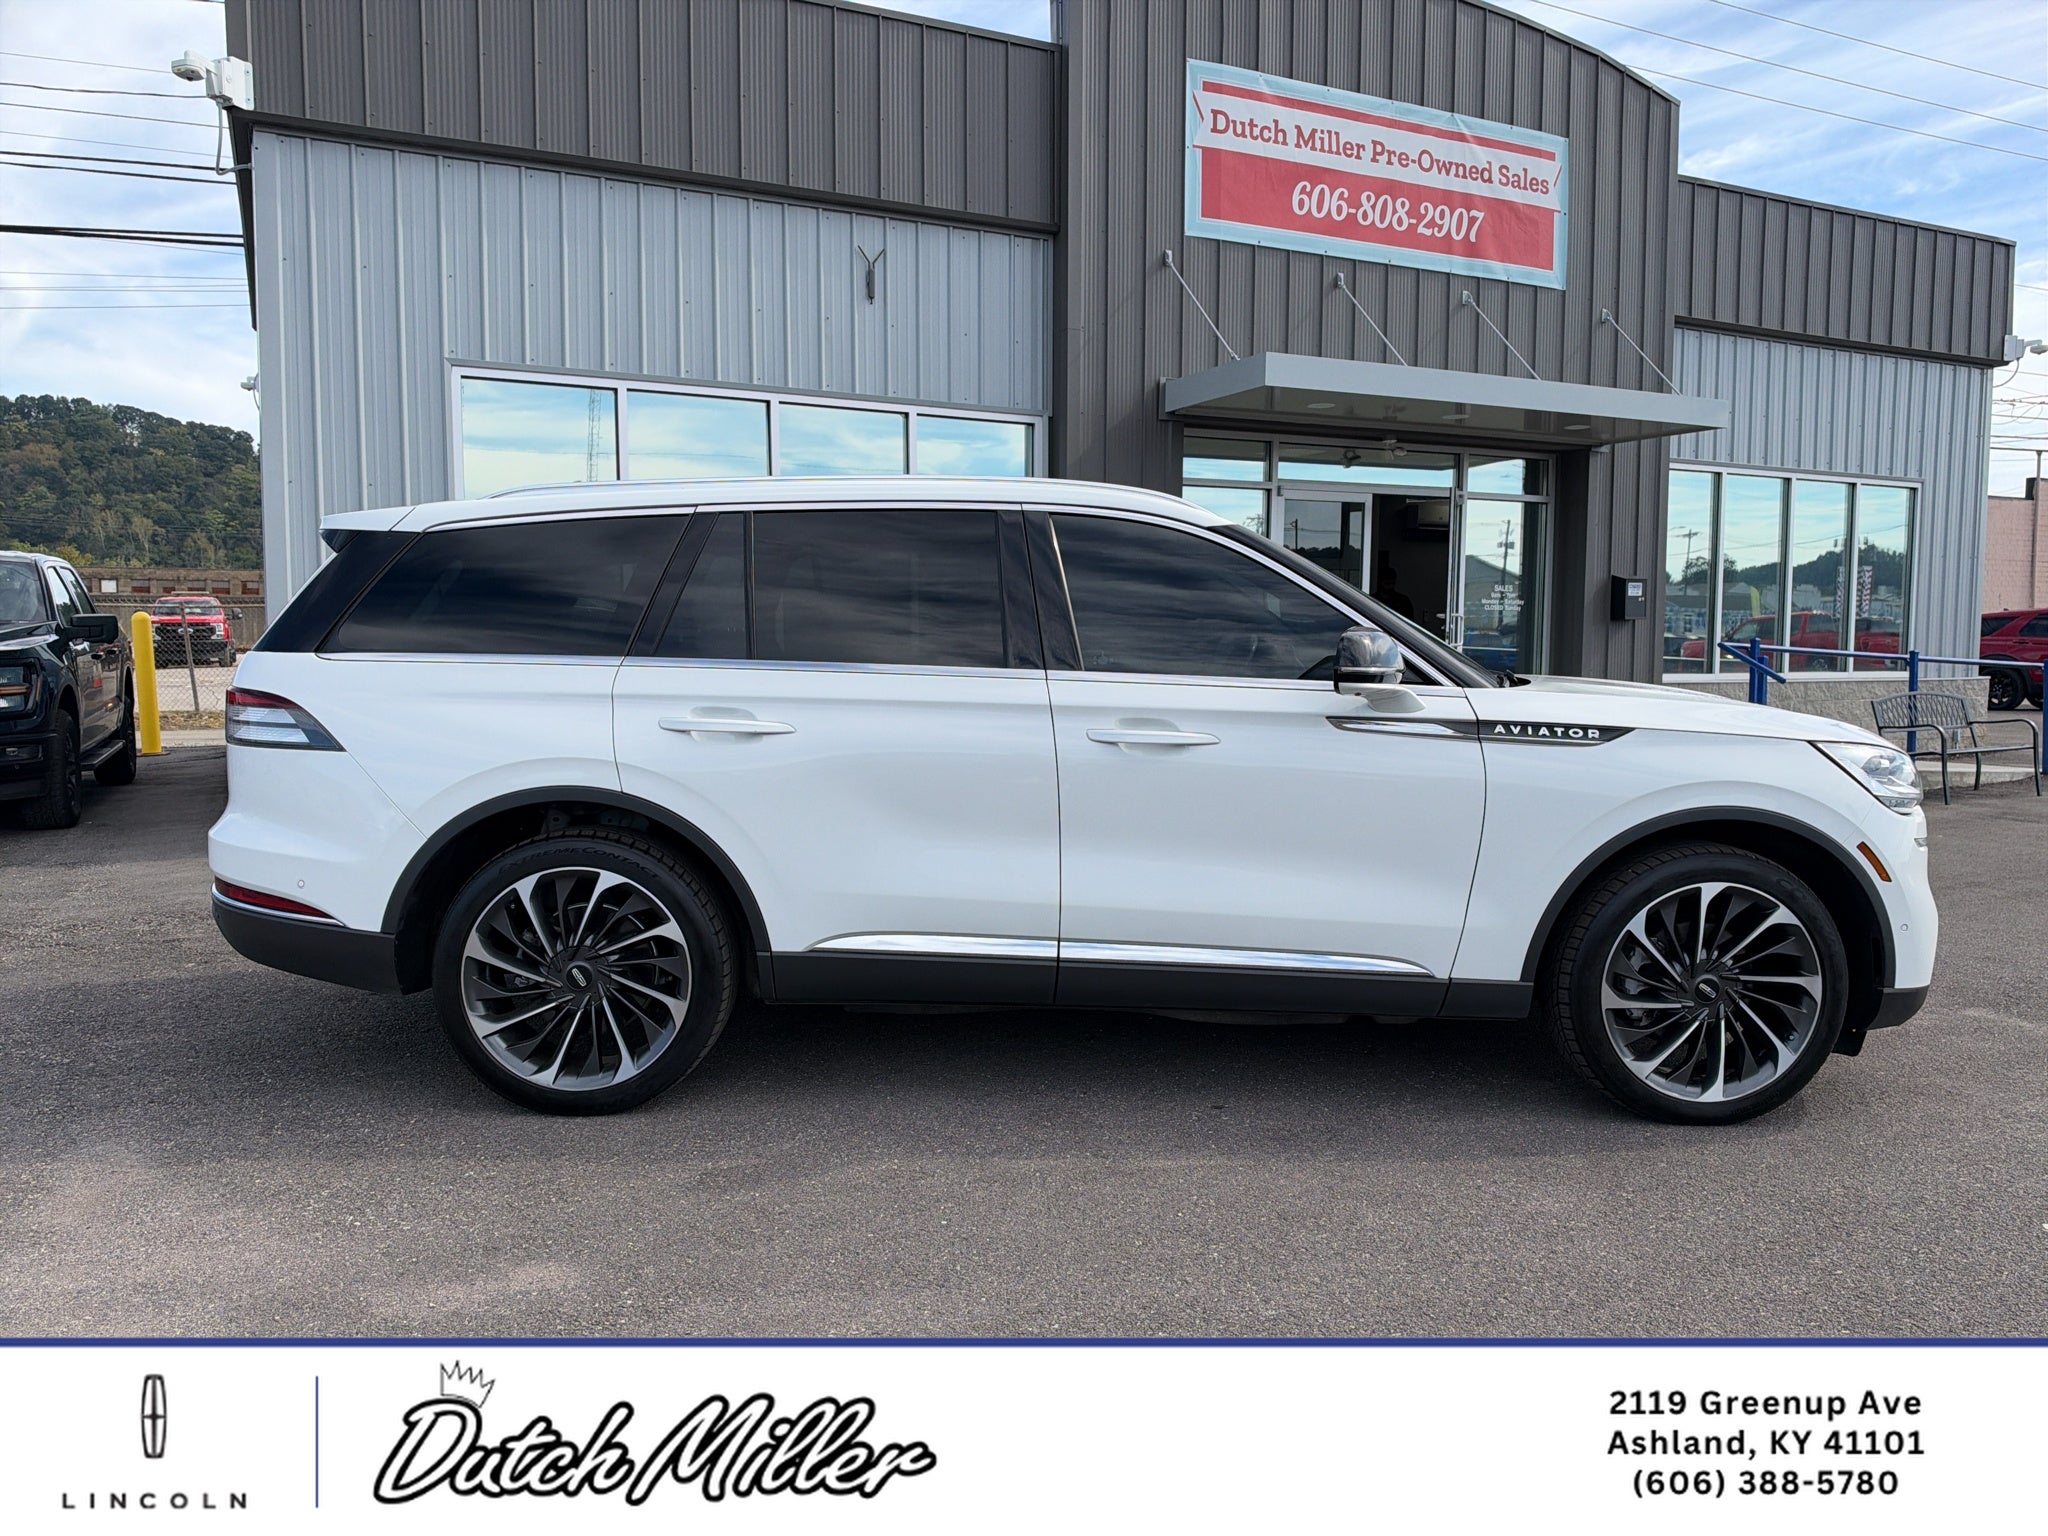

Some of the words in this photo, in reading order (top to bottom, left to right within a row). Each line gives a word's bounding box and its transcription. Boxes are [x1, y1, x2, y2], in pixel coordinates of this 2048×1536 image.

[1210, 108, 1289, 147] Dutch
[1294, 124, 1366, 161] Miller
[1370, 139, 1494, 184] Pre-Owned
[1498, 164, 1550, 195] Sales
[1292, 180, 1485, 243] 606-808-2907
[1493, 724, 1600, 739] AVIATOR
